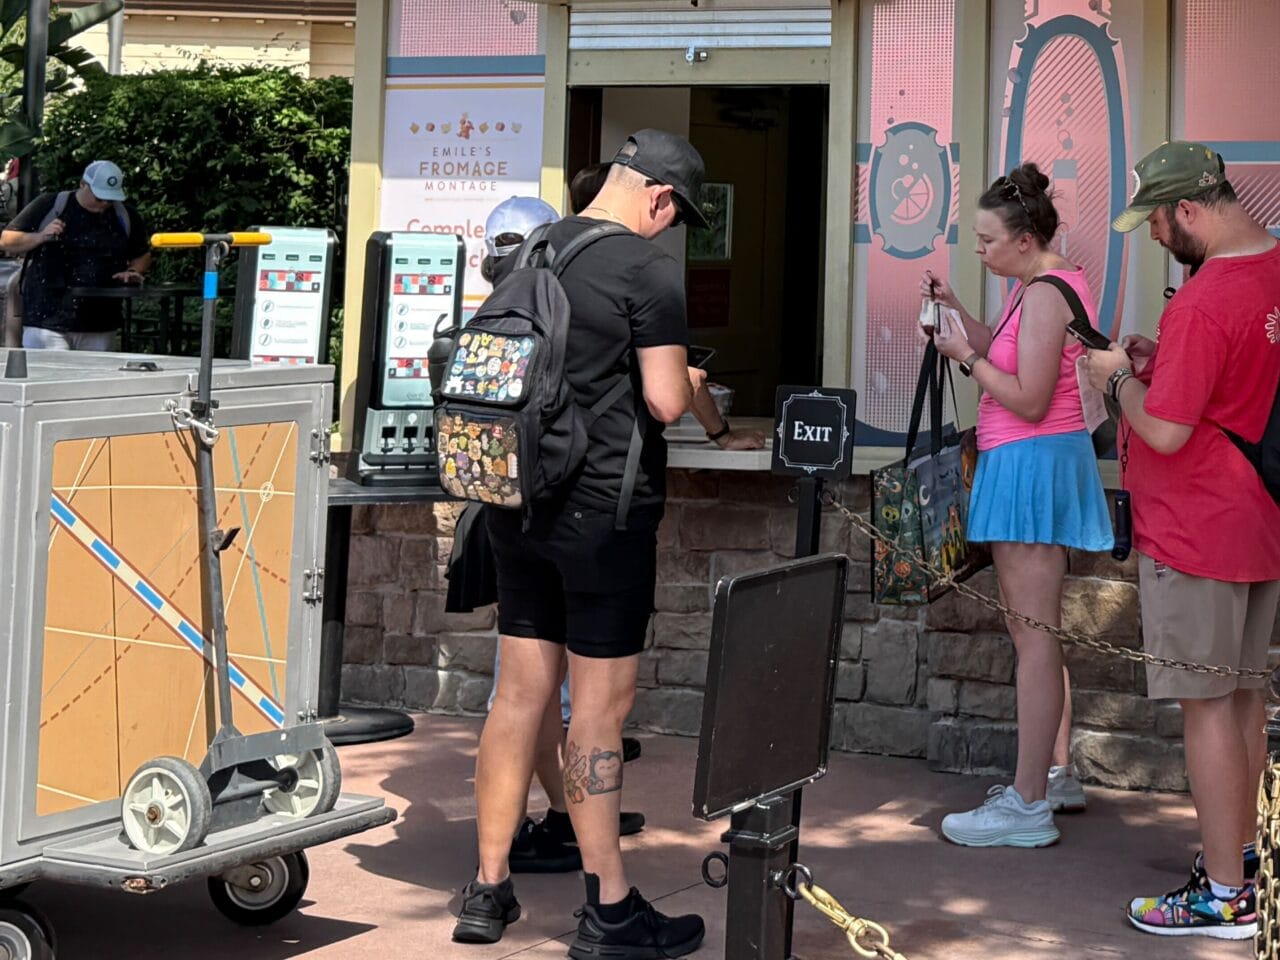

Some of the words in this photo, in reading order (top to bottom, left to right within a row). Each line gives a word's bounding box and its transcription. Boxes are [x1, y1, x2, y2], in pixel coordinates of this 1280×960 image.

[432, 146, 492, 157] EMILE'S
[419, 161, 508, 176] FROMAGE
[424, 181, 497, 191] MONTAGE
[406, 219, 485, 239] Comple
[793, 420, 832, 442] EXIT
